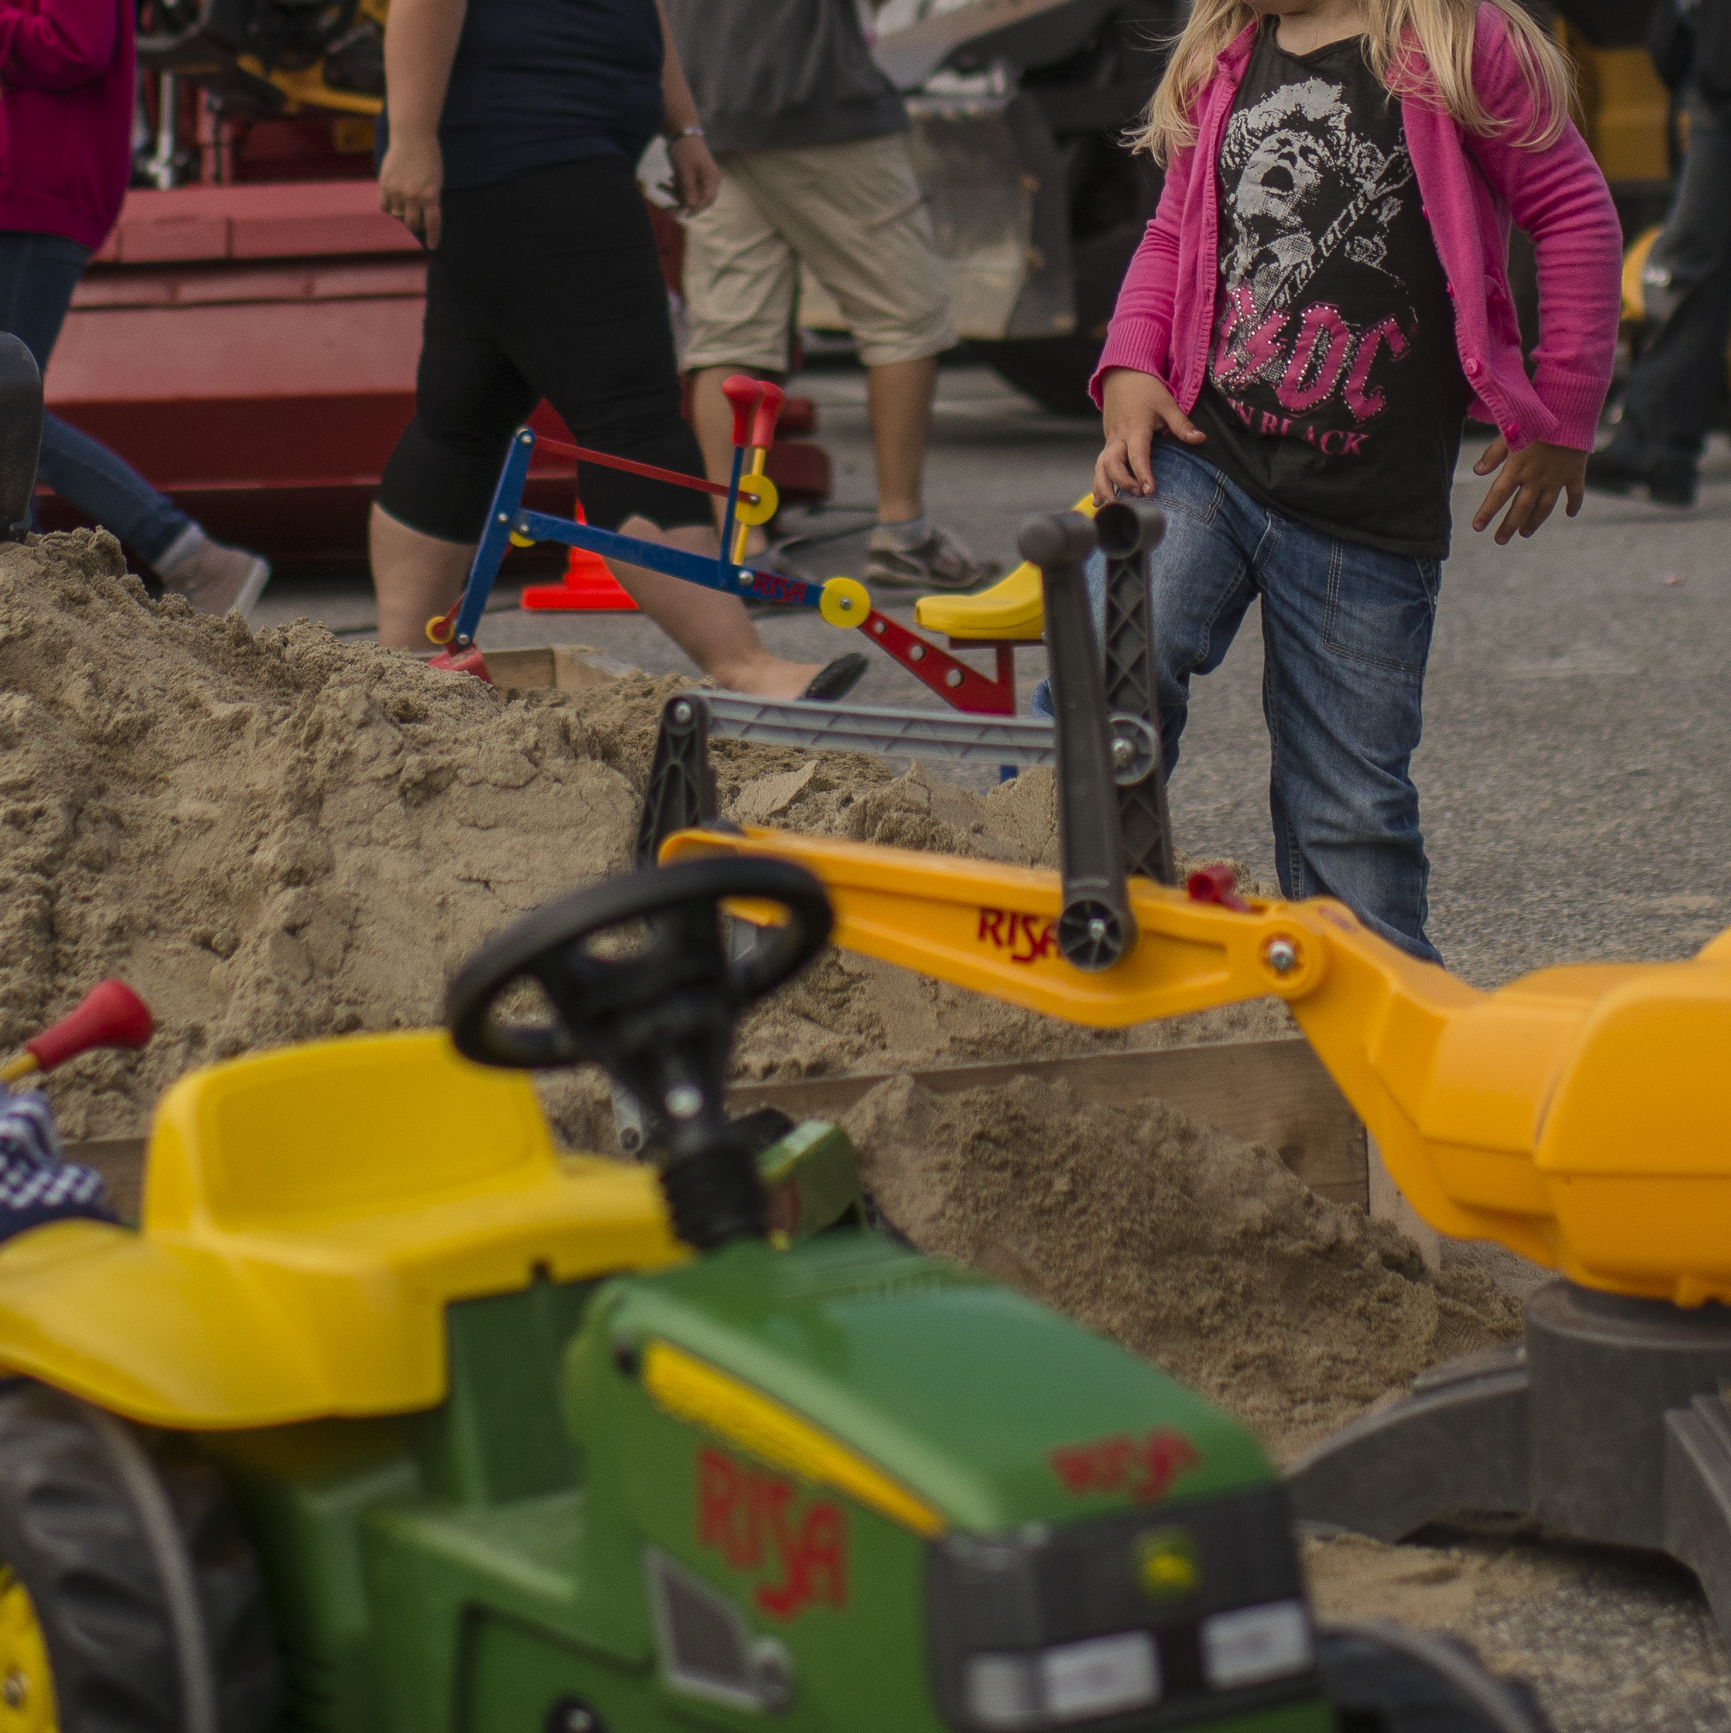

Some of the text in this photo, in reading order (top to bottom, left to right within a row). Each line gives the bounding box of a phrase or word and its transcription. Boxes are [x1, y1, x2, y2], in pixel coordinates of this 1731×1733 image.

[1213, 280, 1411, 425] C/DC
[752, 571, 808, 603] RISA
[696, 1448, 850, 1622] RISA
